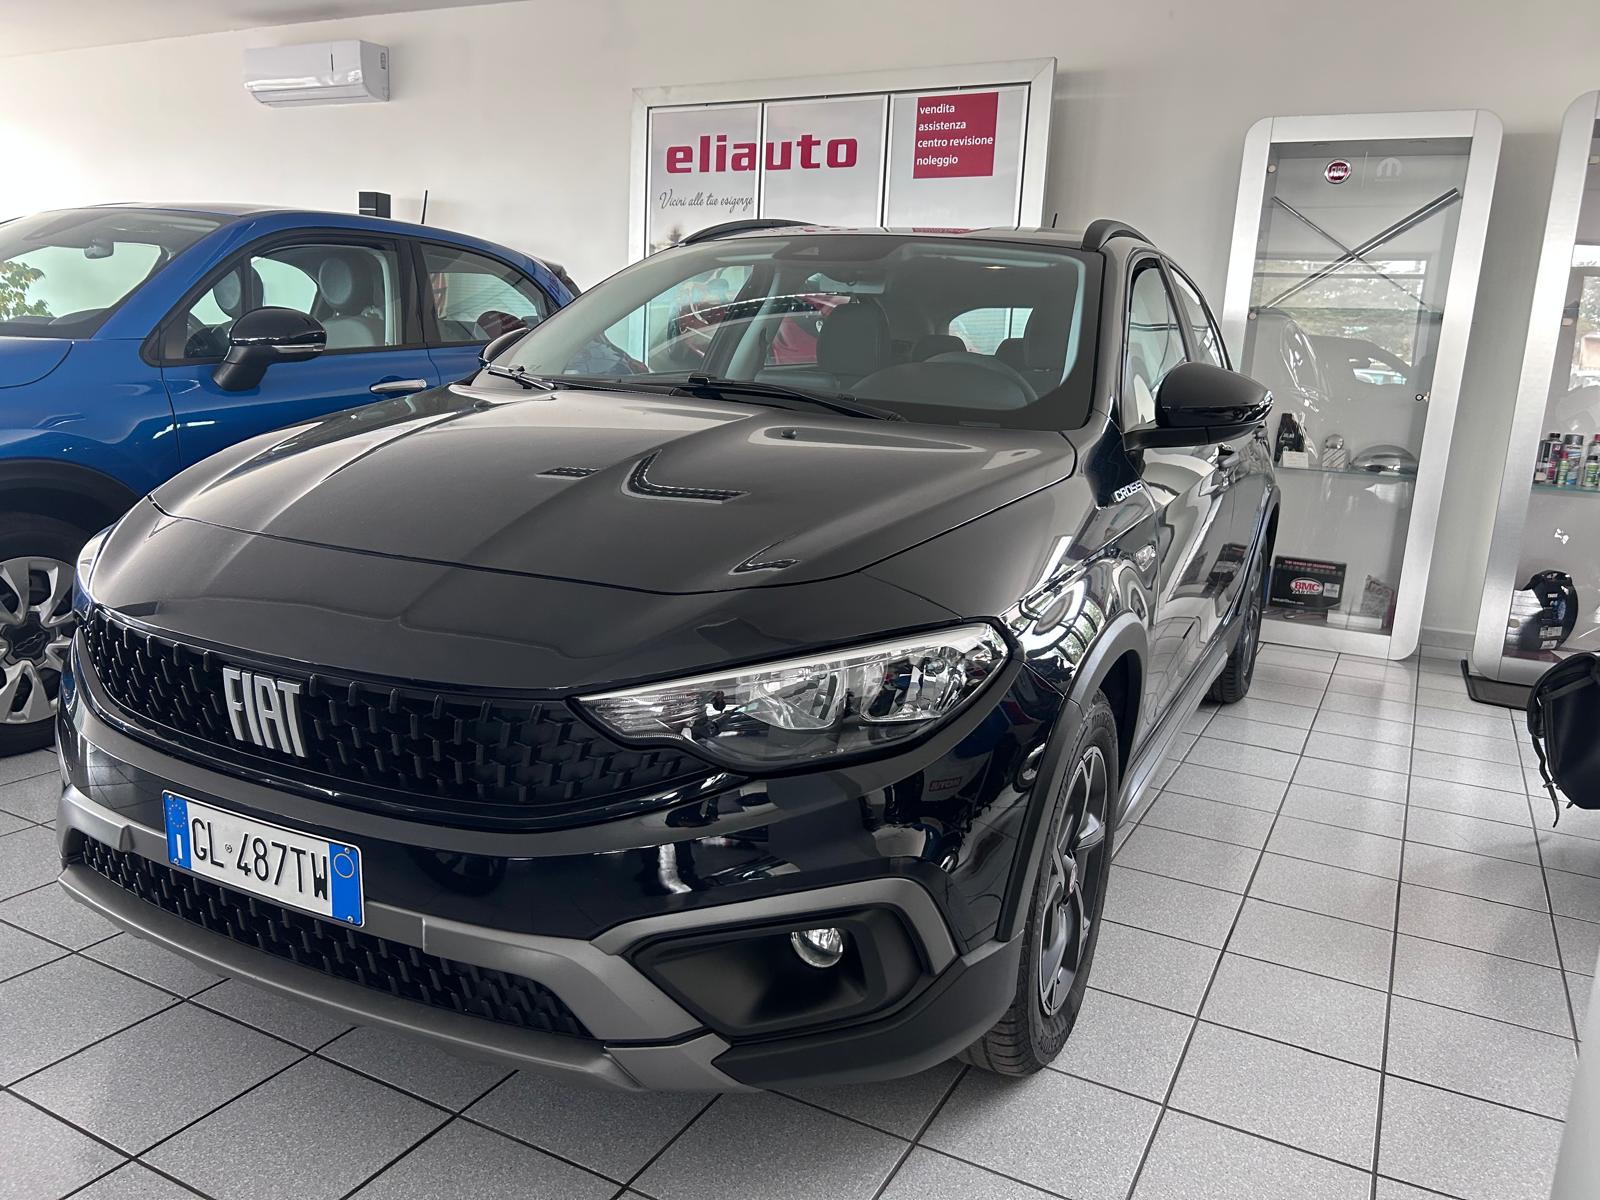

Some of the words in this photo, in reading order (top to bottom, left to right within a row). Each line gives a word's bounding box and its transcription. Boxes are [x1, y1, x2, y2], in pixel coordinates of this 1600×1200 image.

[919, 103, 956, 115] vendita
[918, 120, 967, 132] assistenza
[917, 138, 948, 148] centro
[949, 135, 994, 147] revisione
[666, 134, 858, 174] eliauto
[916, 154, 959, 168] noleggio
[659, 188, 687, 210] Vicini
[688, 191, 704, 207] alle
[705, 192, 718, 207] tue
[720, 196, 754, 214] esigenze
[1113, 480, 1144, 503] CROSS
[1294, 581, 1320, 593] BMC
[222, 667, 305, 758] FIAT
[191, 817, 225, 869] GL
[236, 833, 329, 901] 487TW
